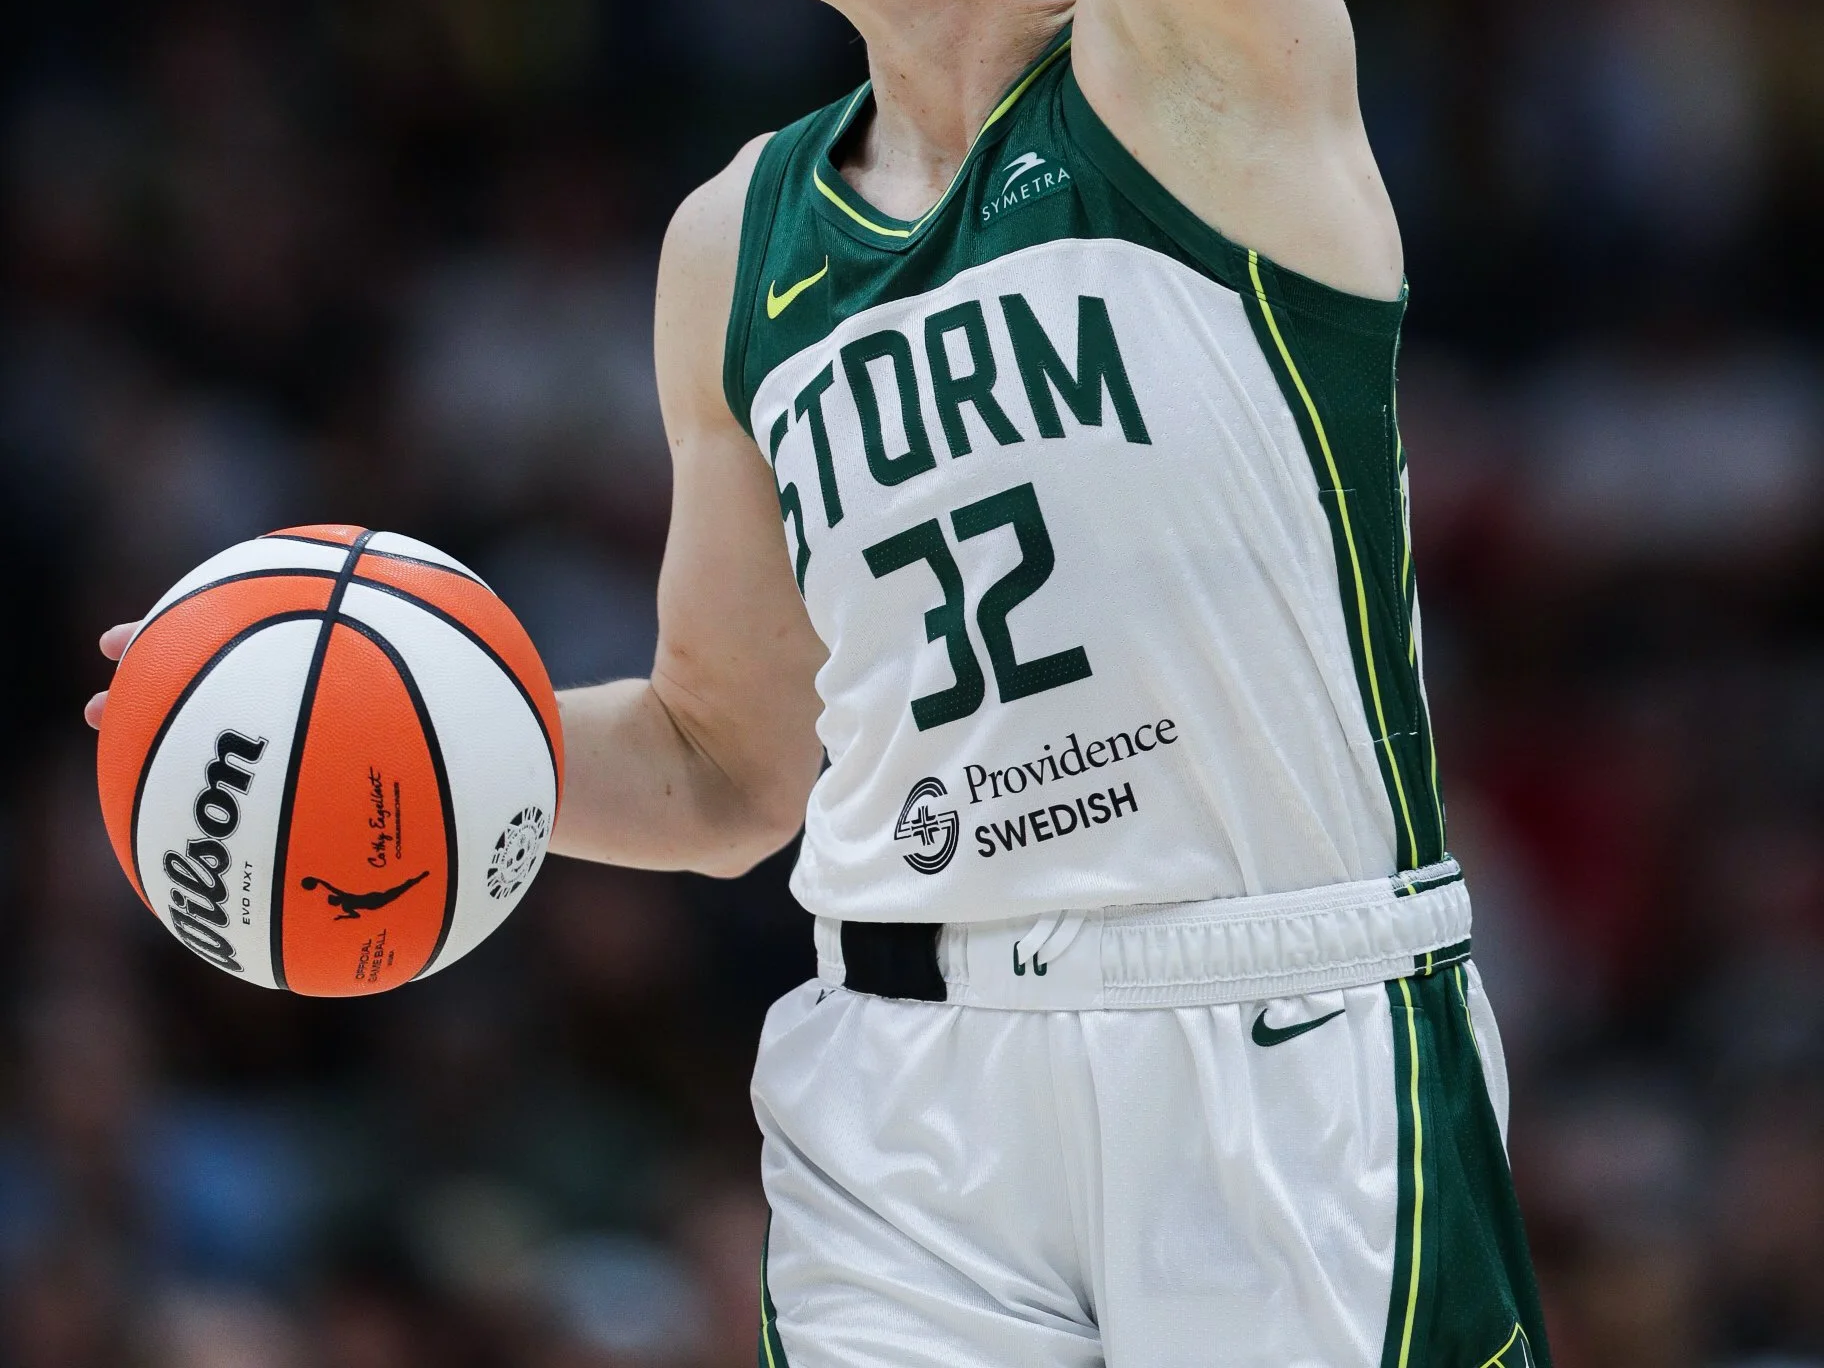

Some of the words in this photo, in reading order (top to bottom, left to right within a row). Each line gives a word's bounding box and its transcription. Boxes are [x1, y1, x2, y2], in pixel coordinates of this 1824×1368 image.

[982, 167, 1071, 221] SYMETRA
[862, 482, 1093, 732] 32
[963, 718, 1179, 804] Providence
[975, 782, 1138, 858] SWEDISH
[163, 729, 269, 973] Wilson
[243, 860, 253, 892] NXT
[242, 898, 251, 925] EVO
[355, 939, 372, 980] OFFICIAL
[373, 928, 386, 957] BALL
